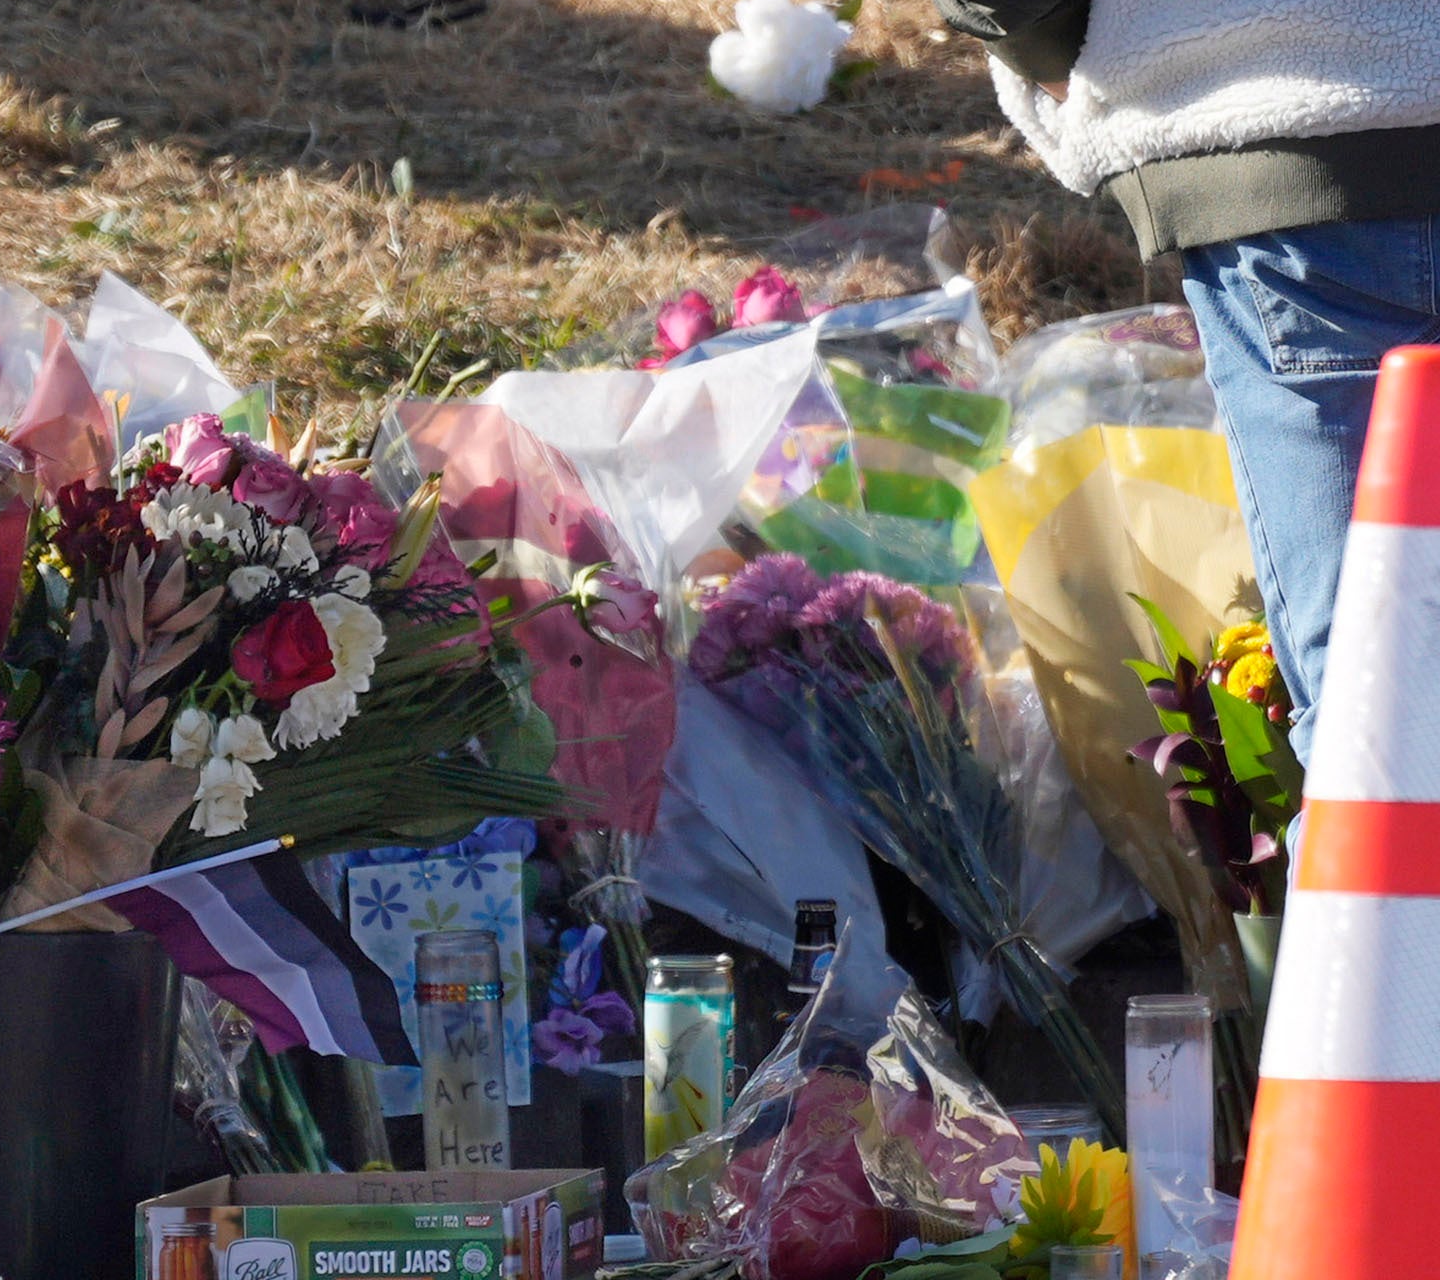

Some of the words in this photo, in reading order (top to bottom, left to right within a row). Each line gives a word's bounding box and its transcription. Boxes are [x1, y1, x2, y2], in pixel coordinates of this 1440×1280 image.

[441, 1023, 490, 1064] We
[434, 1077, 500, 1105] Are
[439, 1124, 504, 1166] Here
[234, 1256, 289, 1280] Ball
[314, 1250, 398, 1275] SMOOTH
[401, 1250, 451, 1274] JARS
